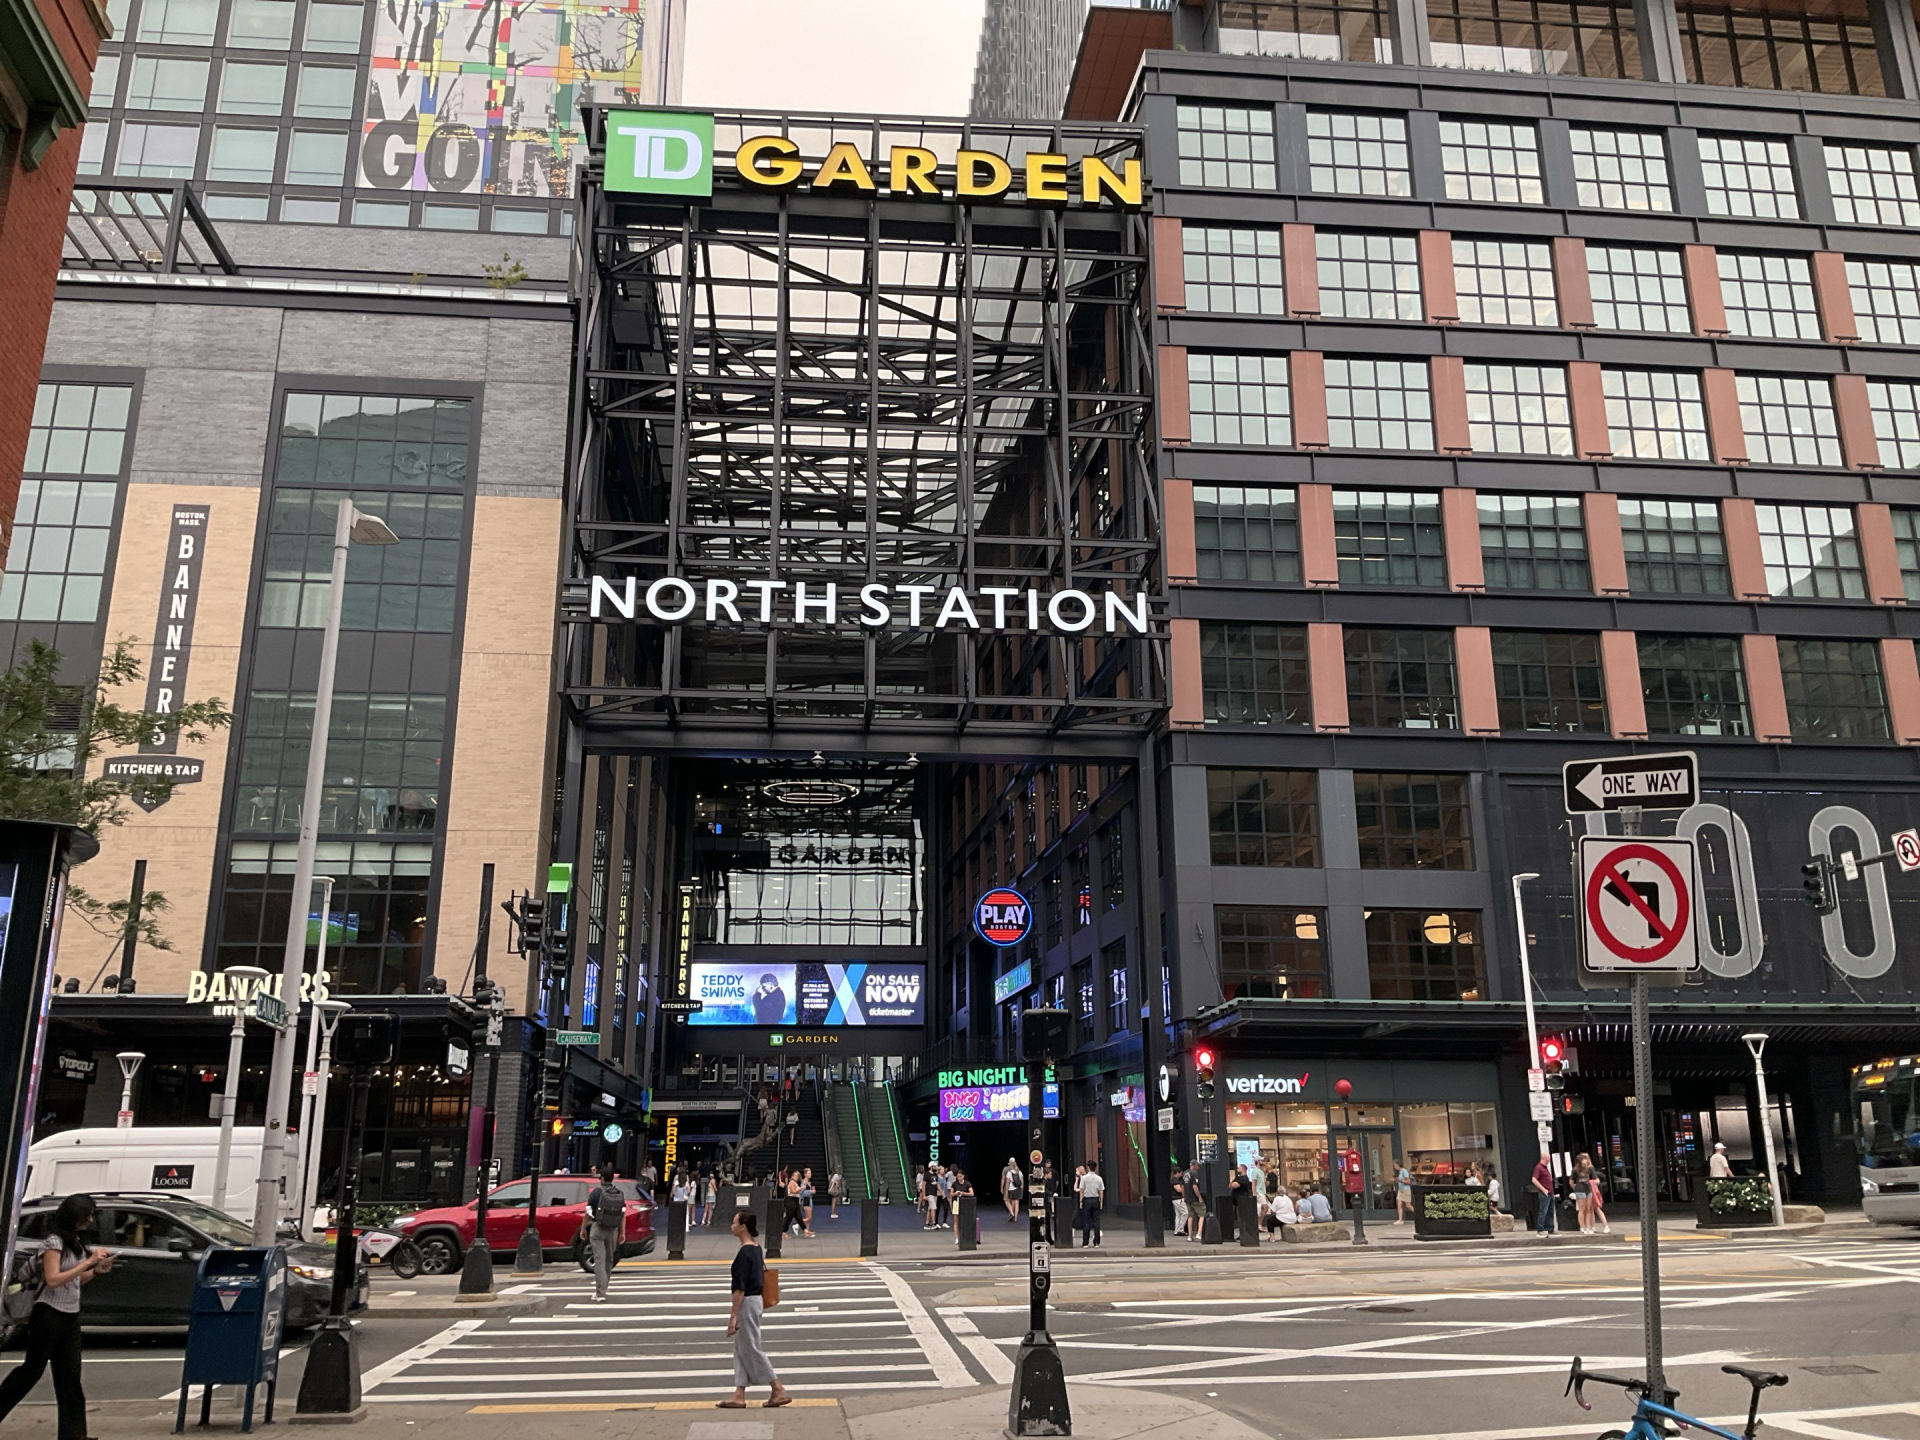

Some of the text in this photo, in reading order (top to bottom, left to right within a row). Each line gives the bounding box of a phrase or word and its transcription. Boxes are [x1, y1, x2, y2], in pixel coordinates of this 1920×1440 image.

[362, 118, 574, 198] GOIN
[618, 126, 1143, 206] TD GARDEN
[590, 575, 1147, 634] NORTH STATION
[108, 763, 200, 775] KITCHEN & TAP
[1602, 772, 1682, 795] ONE WAY
[45, 876, 56, 928] JCDecaux
[980, 904, 1026, 925] PLAY
[678, 895, 690, 996] BANNERS
[186, 970, 332, 1004] BANNERS
[701, 974, 744, 986] TEDDY
[866, 975, 919, 986] ON SALE
[701, 986, 745, 998] SWIMS
[865, 986, 920, 1003] NOW
[256, 995, 279, 1023] CANAL
[868, 1008, 911, 1016] ticketmaster
[561, 1036, 592, 1044] CAUSEWAY
[770, 1036, 782, 1044] TD
[65, 1058, 94, 1072] TOPGOLF
[938, 1071, 963, 1088] BIG
[967, 1067, 1016, 1086] NIGHT
[1226, 1074, 1300, 1092] verizon
[944, 1092, 980, 1108] BINGO
[990, 1085, 1029, 1112] BOSTO
[1624, 1096, 1636, 1106] 100
[950, 1106, 974, 1120] LOCO
[930, 1128, 939, 1166] STUD
[154, 1178, 188, 1186] LOOMIS
